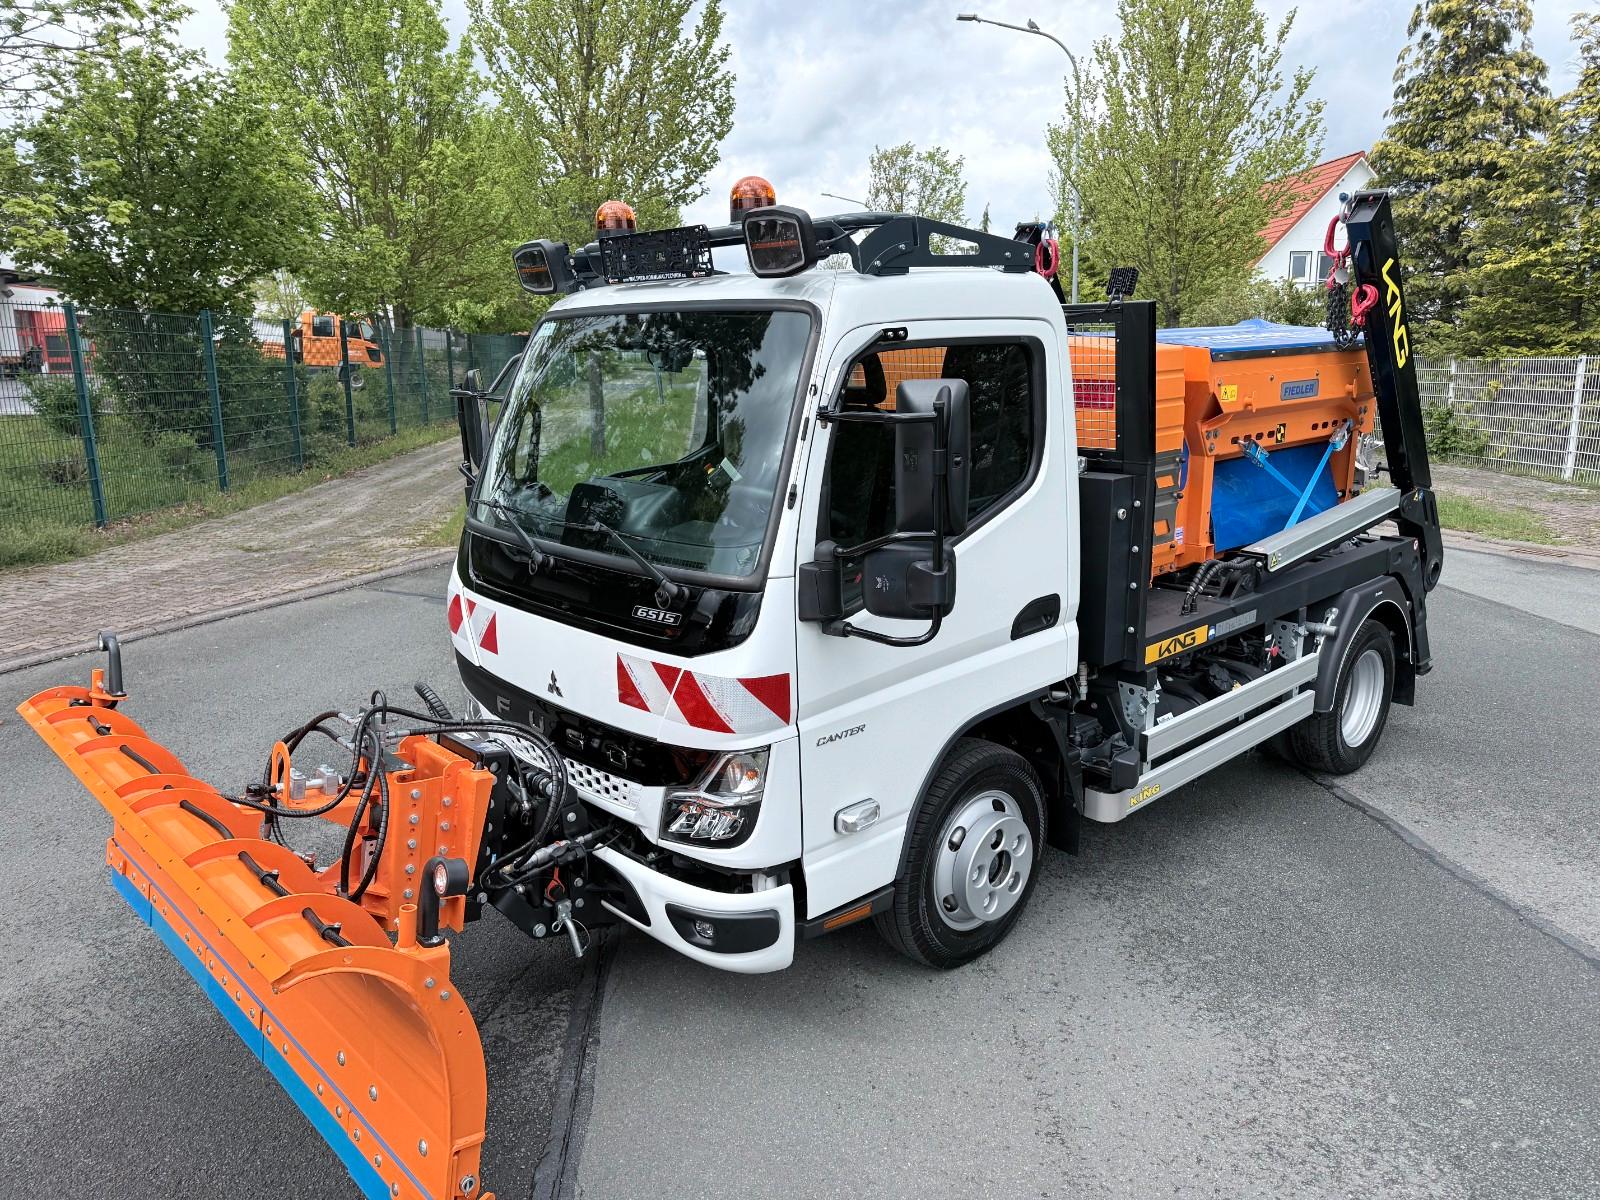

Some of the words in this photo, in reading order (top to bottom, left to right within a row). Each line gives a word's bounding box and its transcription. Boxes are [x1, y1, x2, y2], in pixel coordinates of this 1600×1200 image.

[1284, 383, 1315, 396] FIEDLER
[496, 695, 628, 770] FUSO
[816, 723, 866, 747] CANTER
[1129, 784, 1160, 807] KING
